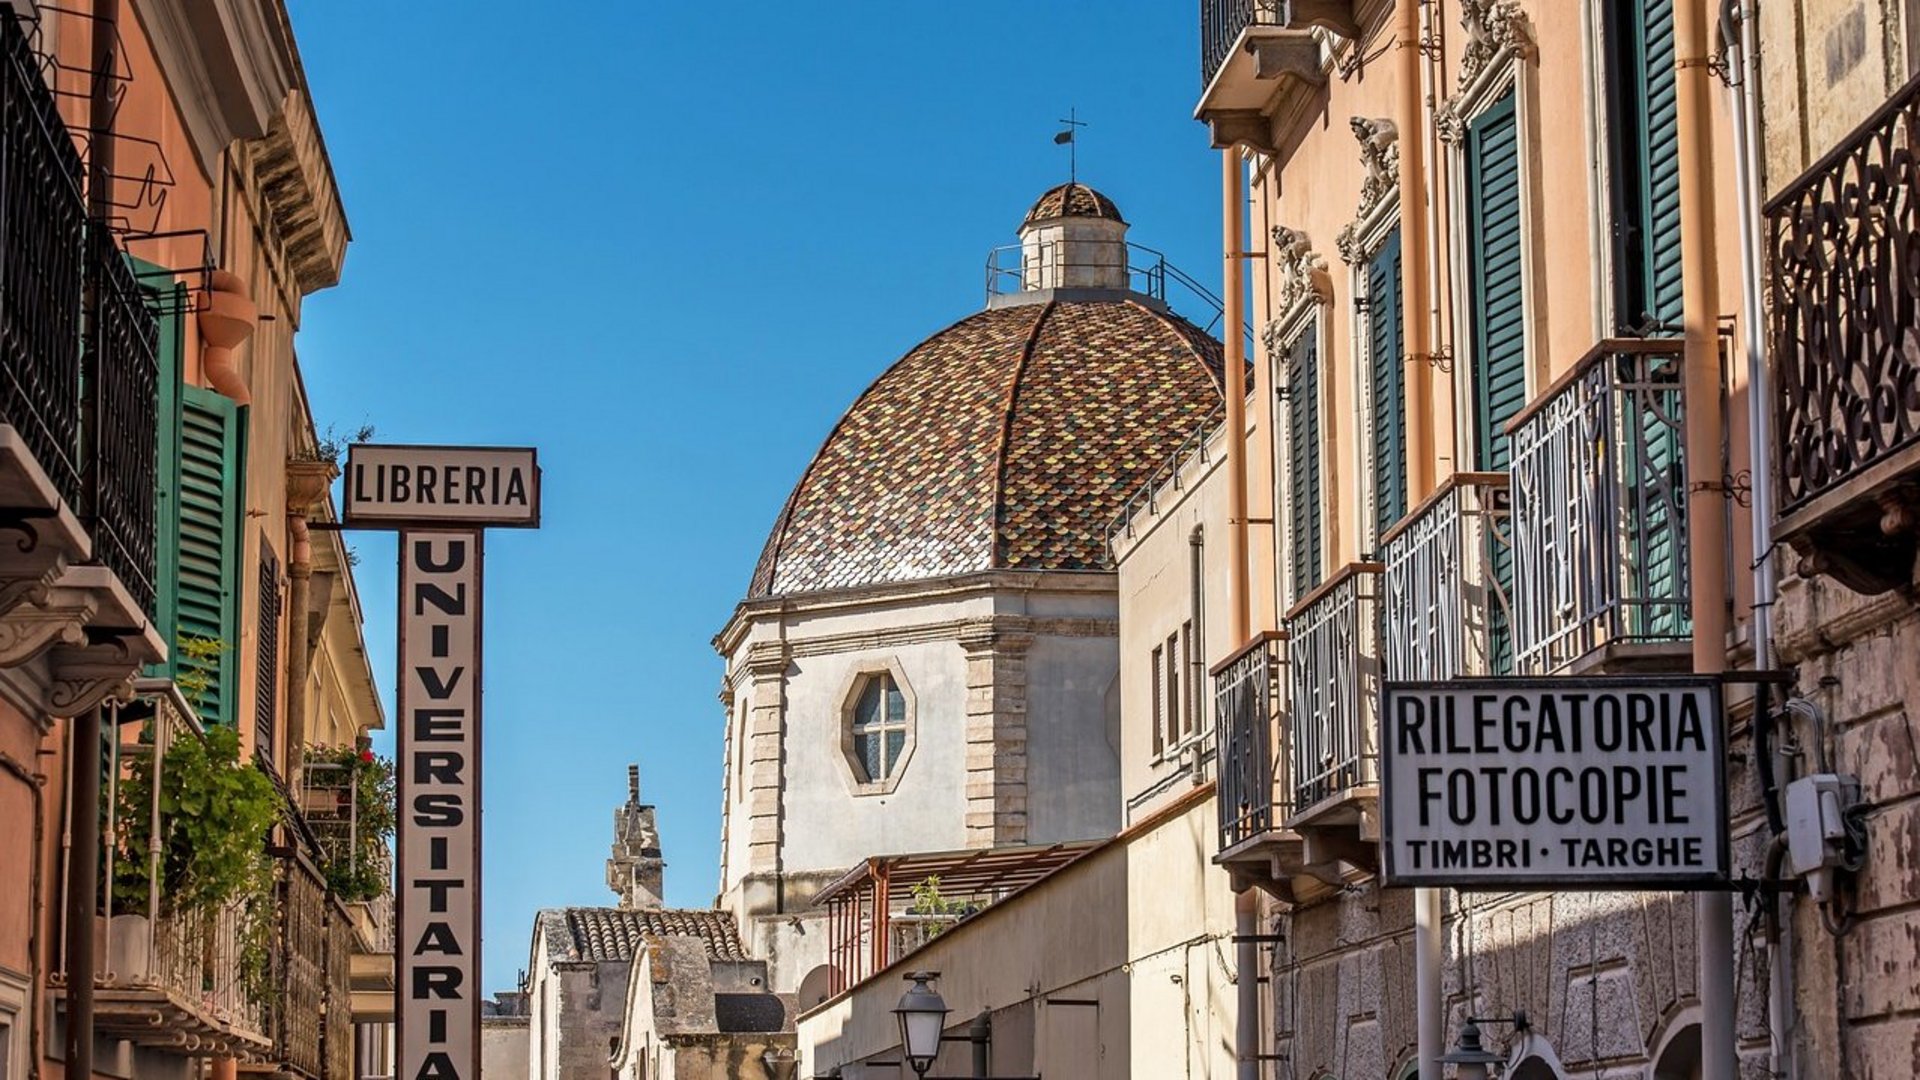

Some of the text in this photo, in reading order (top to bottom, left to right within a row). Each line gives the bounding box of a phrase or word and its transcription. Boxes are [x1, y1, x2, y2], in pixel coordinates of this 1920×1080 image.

[355, 464, 528, 506] LIBRERIA
[1397, 692, 1706, 755] RILEGATORIA
[413, 541, 465, 1080] UNIVERSITARIA
[1418, 764, 1690, 827] FOTOCOPIE
[1406, 837, 1703, 869] TIMBRI TARGHE
